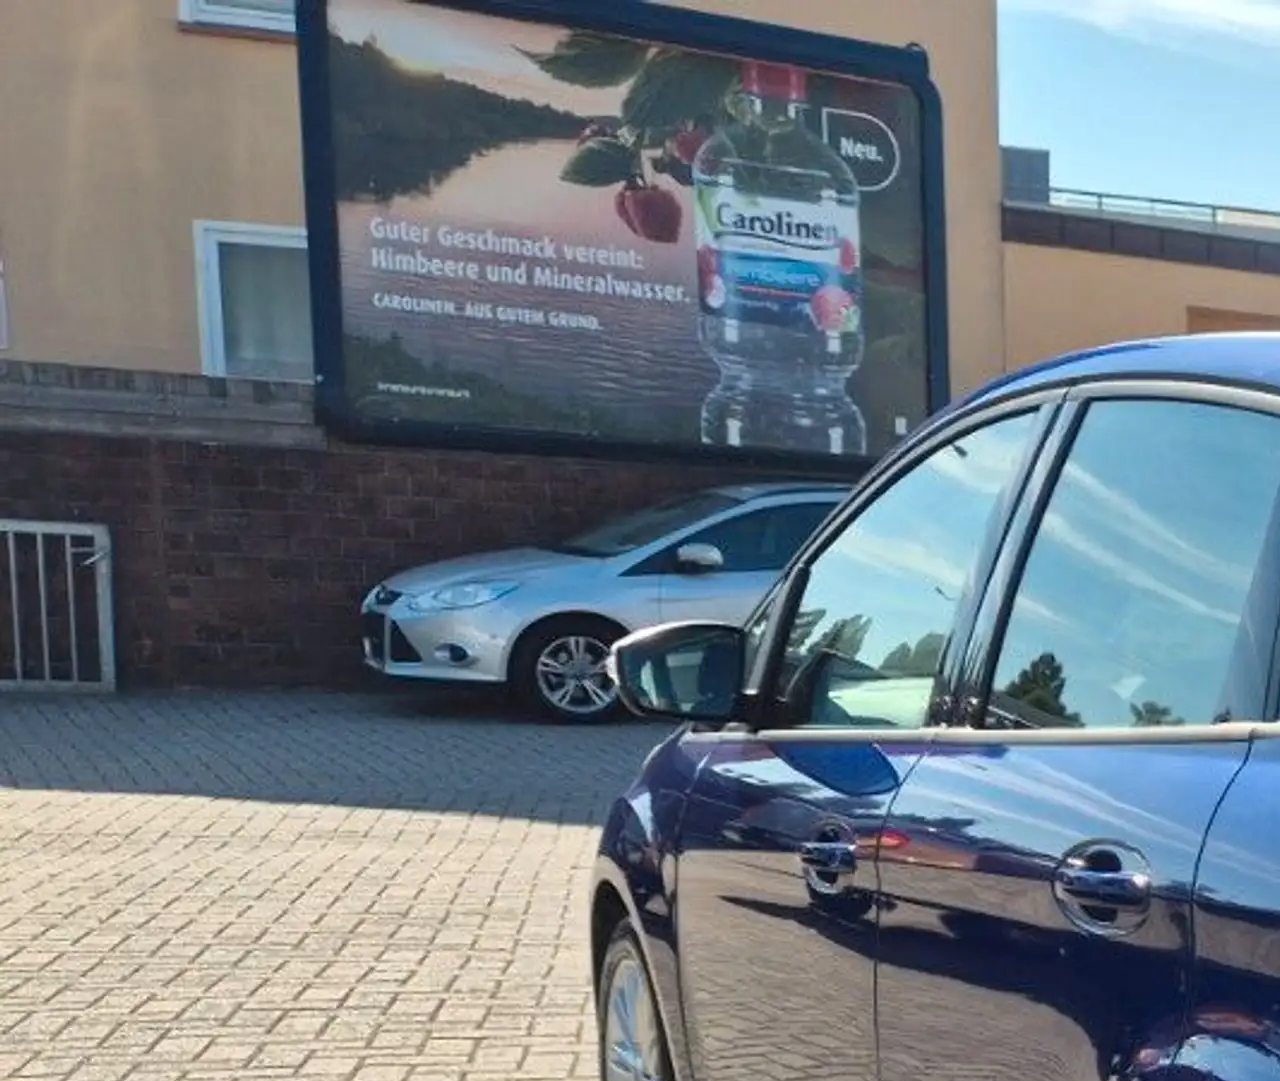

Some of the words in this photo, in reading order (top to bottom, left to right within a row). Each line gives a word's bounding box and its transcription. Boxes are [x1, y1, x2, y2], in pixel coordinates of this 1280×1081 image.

[840, 136, 884, 164] Neu.
[716, 202, 838, 240] Carolinen
[370, 217, 429, 244] Guter
[437, 226, 557, 260] Geschmack
[564, 243, 645, 270] vereint:
[371, 248, 479, 280] Himbeere
[486, 262, 527, 285] und
[533, 266, 691, 303] Mineralwasser.
[465, 301, 493, 319] AUS
[497, 306, 544, 324] GUTEM
[548, 311, 604, 331] GRUND.
